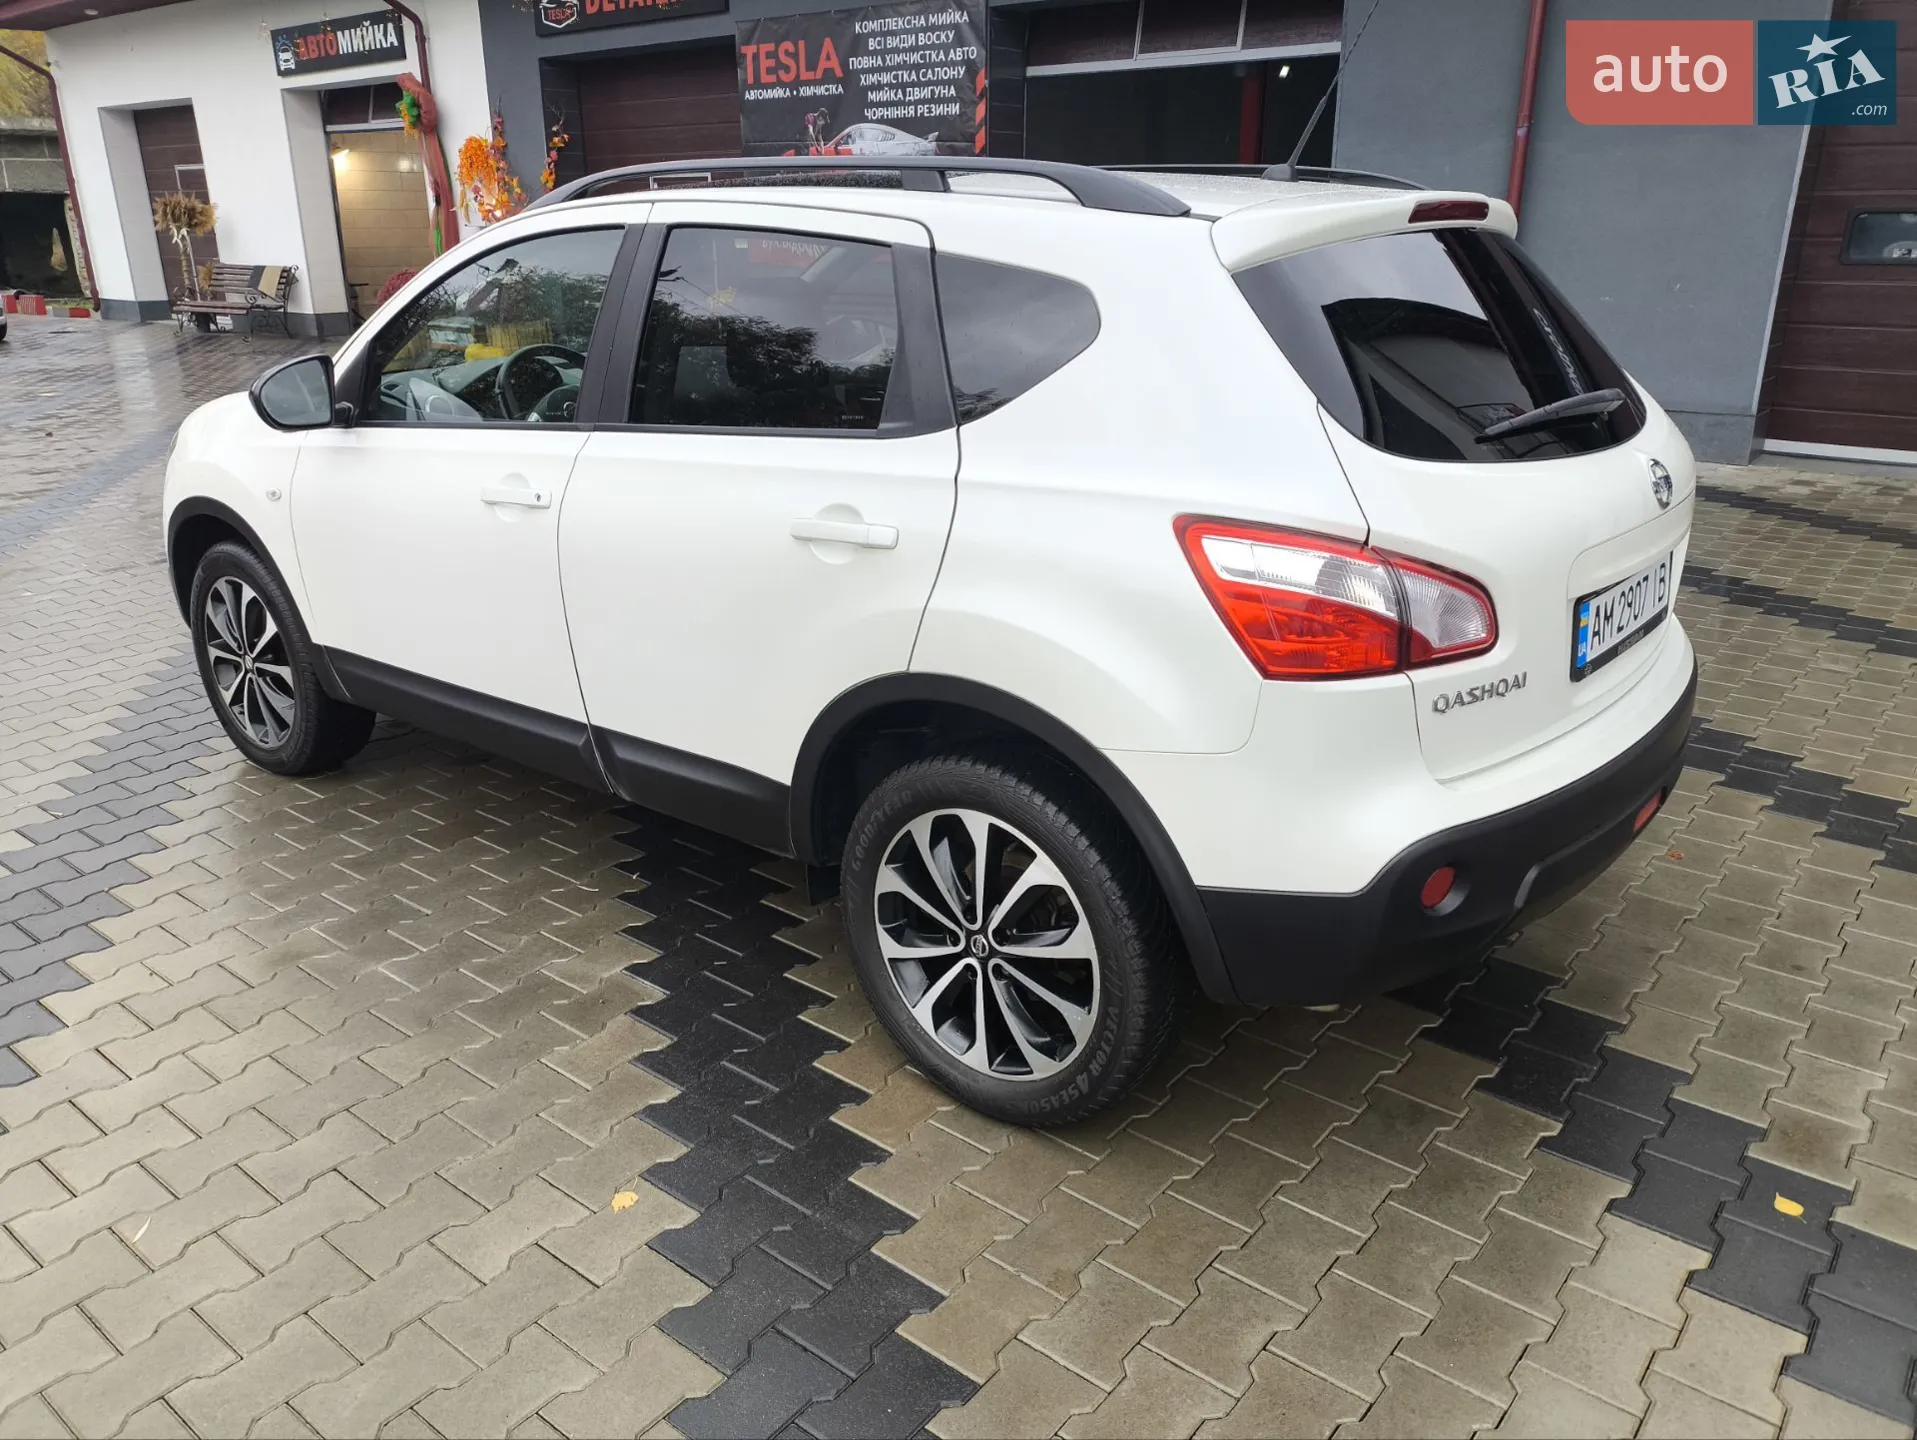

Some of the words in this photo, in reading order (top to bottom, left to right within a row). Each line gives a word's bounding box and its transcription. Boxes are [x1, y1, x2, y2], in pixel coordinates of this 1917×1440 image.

[855, 14, 926, 34] КОМПЛЕКСНА
[928, 9, 969, 26] МИЙКА
[298, 20, 399, 61] АВТОМИЙКА
[868, 37, 885, 50] ВСІ
[887, 33, 916, 49] ВИДИ
[918, 30, 955, 46] ВОСКУ
[741, 37, 844, 84] TESLA
[849, 55, 883, 70] ПОВНА
[885, 49, 946, 66] ХІМЧИСТКА
[947, 46, 978, 61] АВТО
[860, 69, 918, 86] ХІМЧИСТКА
[919, 66, 966, 82] САЛОНУ
[745, 87, 792, 101] АВТОМИЙКА
[799, 83, 844, 97] ХІМЧИСТКА
[867, 87, 904, 103] МИЙКА
[905, 85, 957, 102] ДВИГУНА
[864, 105, 915, 120] ЧОРНІННЯ
[917, 102, 960, 118] РЕЗИНИ
[1590, 596, 1616, 651] AM
[1616, 573, 1649, 635] 2907
[1652, 561, 1667, 608] IB
[1431, 671, 1528, 714] QASHQAI
